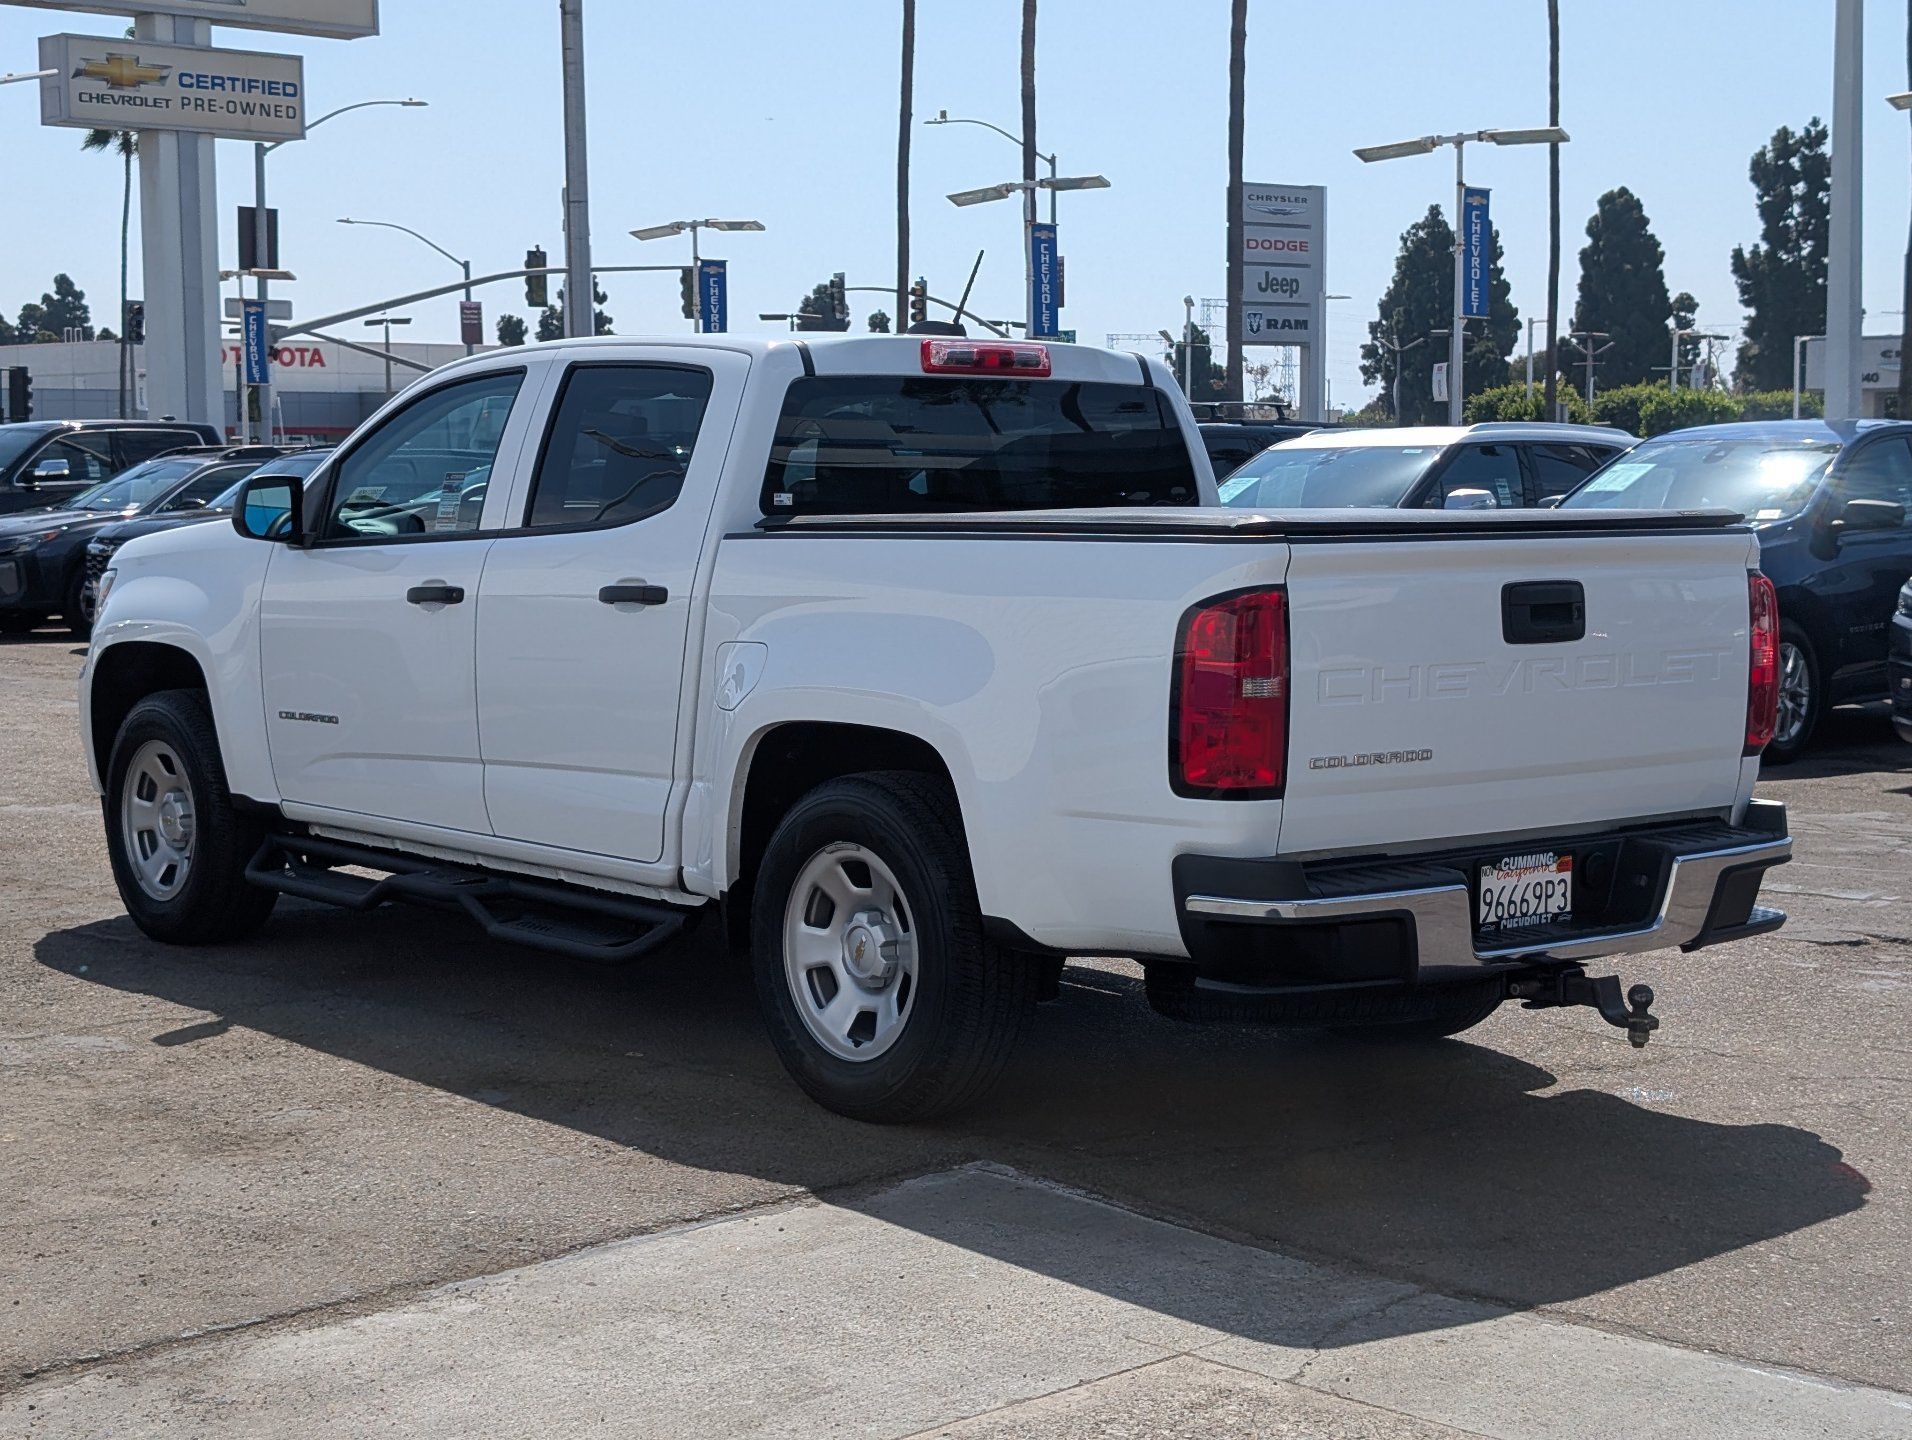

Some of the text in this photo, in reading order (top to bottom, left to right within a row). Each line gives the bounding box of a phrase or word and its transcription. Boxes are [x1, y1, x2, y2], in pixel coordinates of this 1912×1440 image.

[178, 72, 298, 98] CERTIFIED
[78, 91, 173, 109] CHEVROLET
[181, 96, 297, 120] PRE-OWNED
[1248, 193, 1308, 204] CHRYSLER
[1246, 238, 1309, 252] DODGE
[1471, 210, 1481, 314] CHEVROLET
[1040, 243, 1051, 334] CHEVROLET
[1257, 270, 1300, 298] Jeep
[1266, 318, 1309, 331] RAM
[249, 315, 261, 382] CHEVROLET
[1316, 645, 1734, 706] CHEVROLET
[278, 710, 340, 725] COLORADO
[1309, 748, 1433, 770] COLORADO
[1501, 852, 1553, 870] CUMMING
[1482, 878, 1568, 923] 96669P3
[1501, 913, 1553, 930] CHEVROLET
